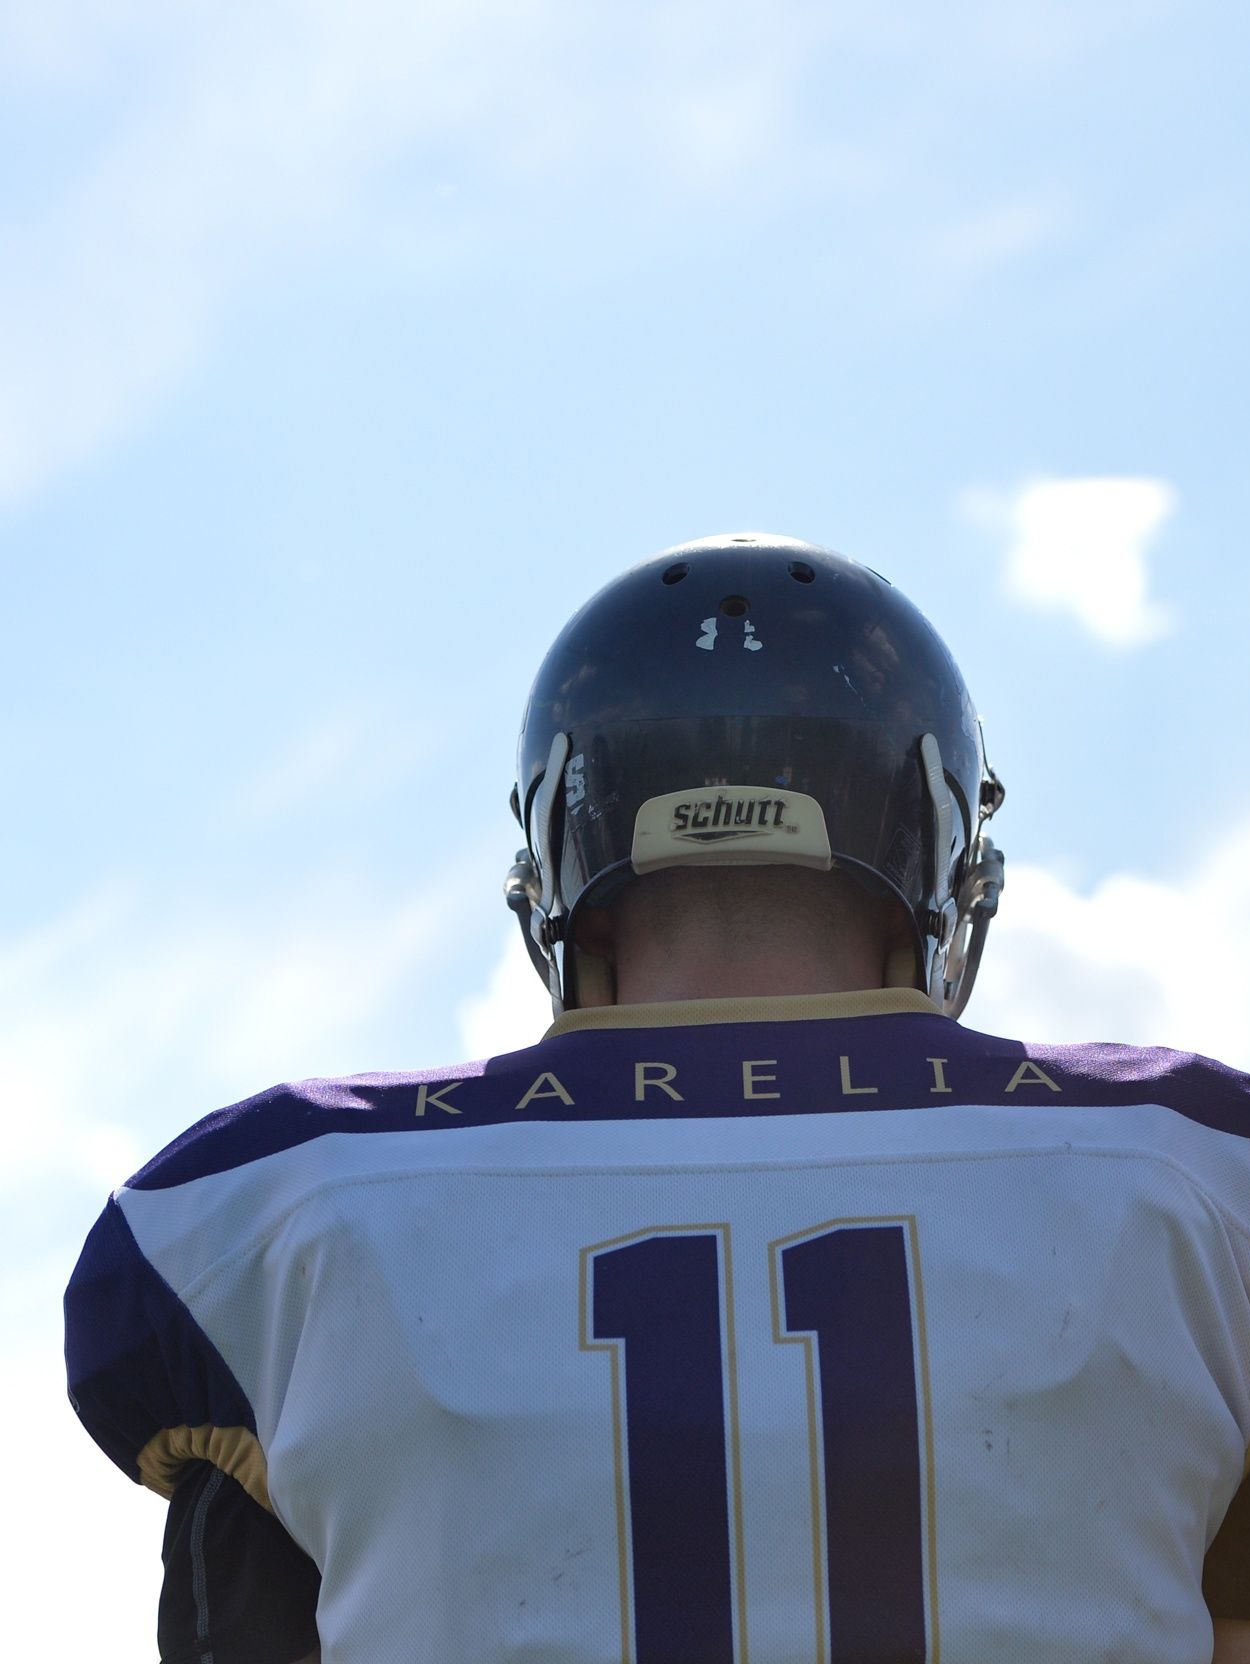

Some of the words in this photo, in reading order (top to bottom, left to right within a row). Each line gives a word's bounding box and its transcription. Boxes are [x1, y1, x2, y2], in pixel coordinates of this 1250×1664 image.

[673, 794, 787, 831] schutt
[415, 1055, 1062, 1117] KARELIA
[578, 1214, 941, 1664] 11
